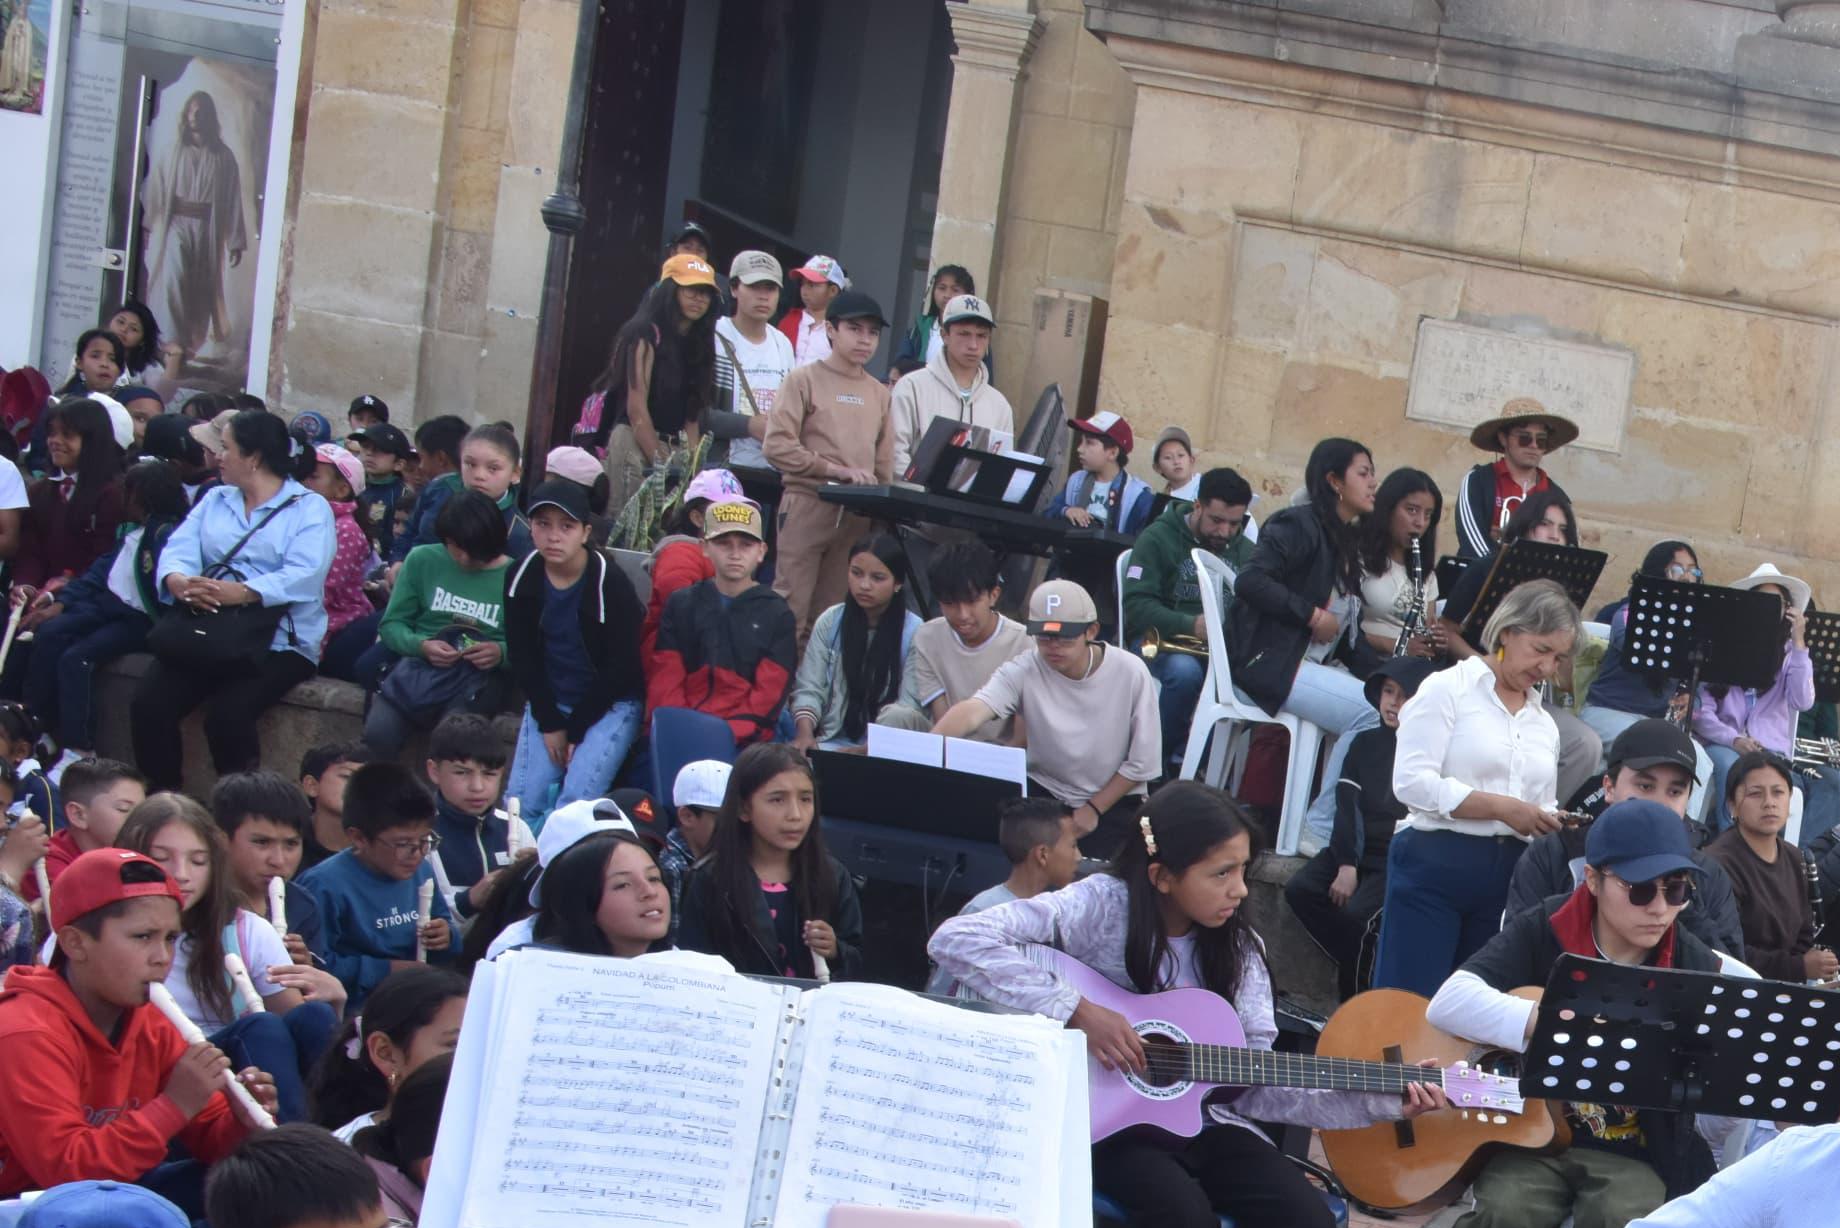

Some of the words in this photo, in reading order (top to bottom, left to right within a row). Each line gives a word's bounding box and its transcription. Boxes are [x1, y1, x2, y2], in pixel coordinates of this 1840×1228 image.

[687, 260, 710, 273] FILA
[712, 504, 754, 517] LOONEY
[716, 513, 751, 525] TUNES
[430, 586, 500, 629] BASEBALL
[1047, 594, 1061, 615] P
[376, 910, 420, 929] STRONG
[592, 967, 636, 979] NAVIDAD
[660, 974, 727, 993] COLOMBIANA
